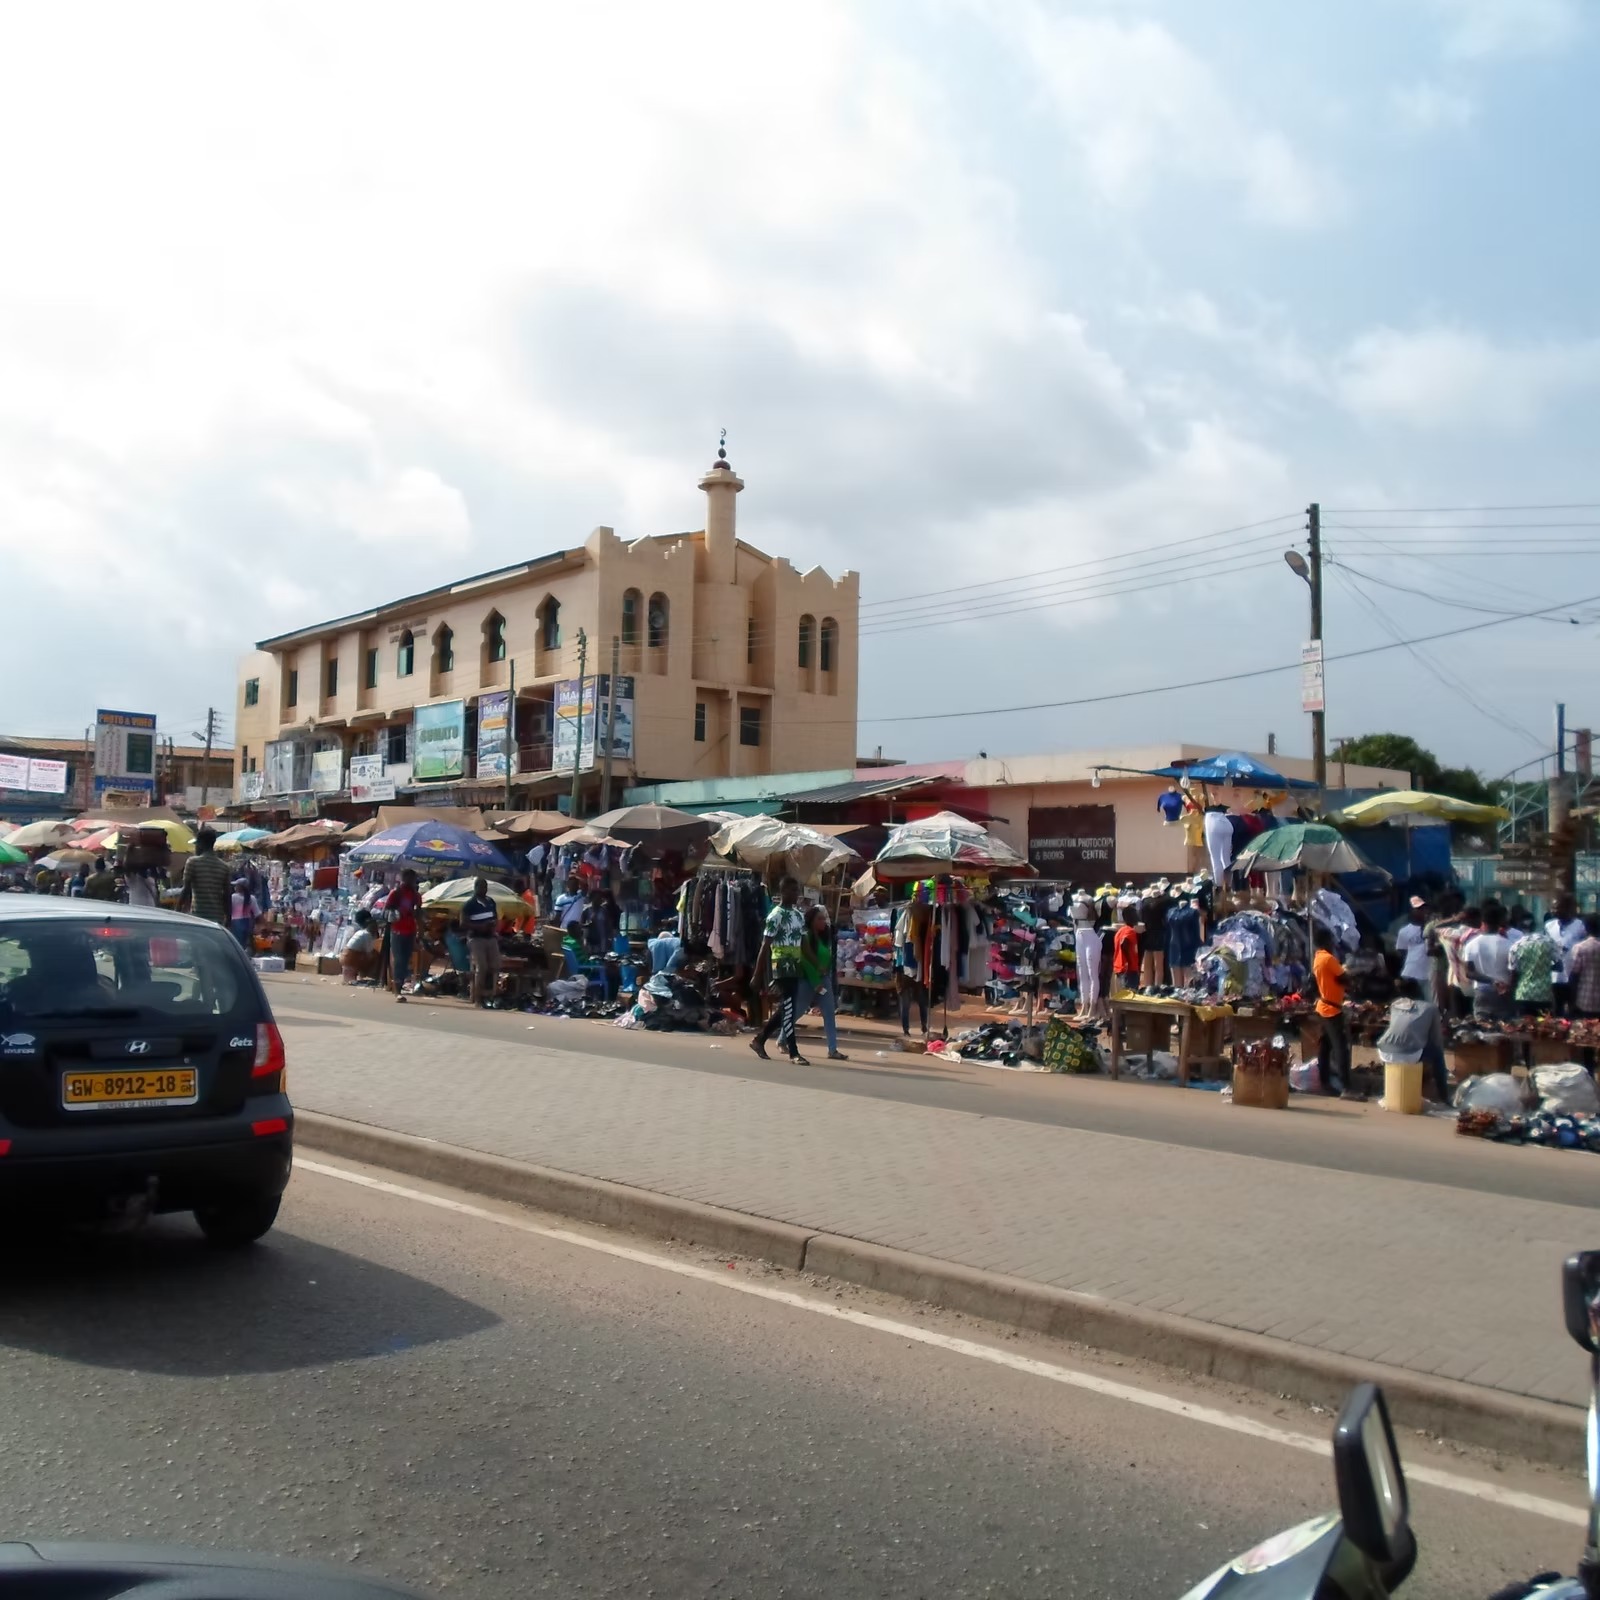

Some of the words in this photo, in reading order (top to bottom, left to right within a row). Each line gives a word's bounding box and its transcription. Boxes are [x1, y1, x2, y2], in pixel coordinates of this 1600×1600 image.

[1043, 850, 1065, 860] BOOKS
[1081, 849, 1109, 860] CENTRE
[229, 1037, 254, 1048] Getz
[72, 1079, 93, 1097] GW
[103, 1075, 176, 1096] 8912-18
